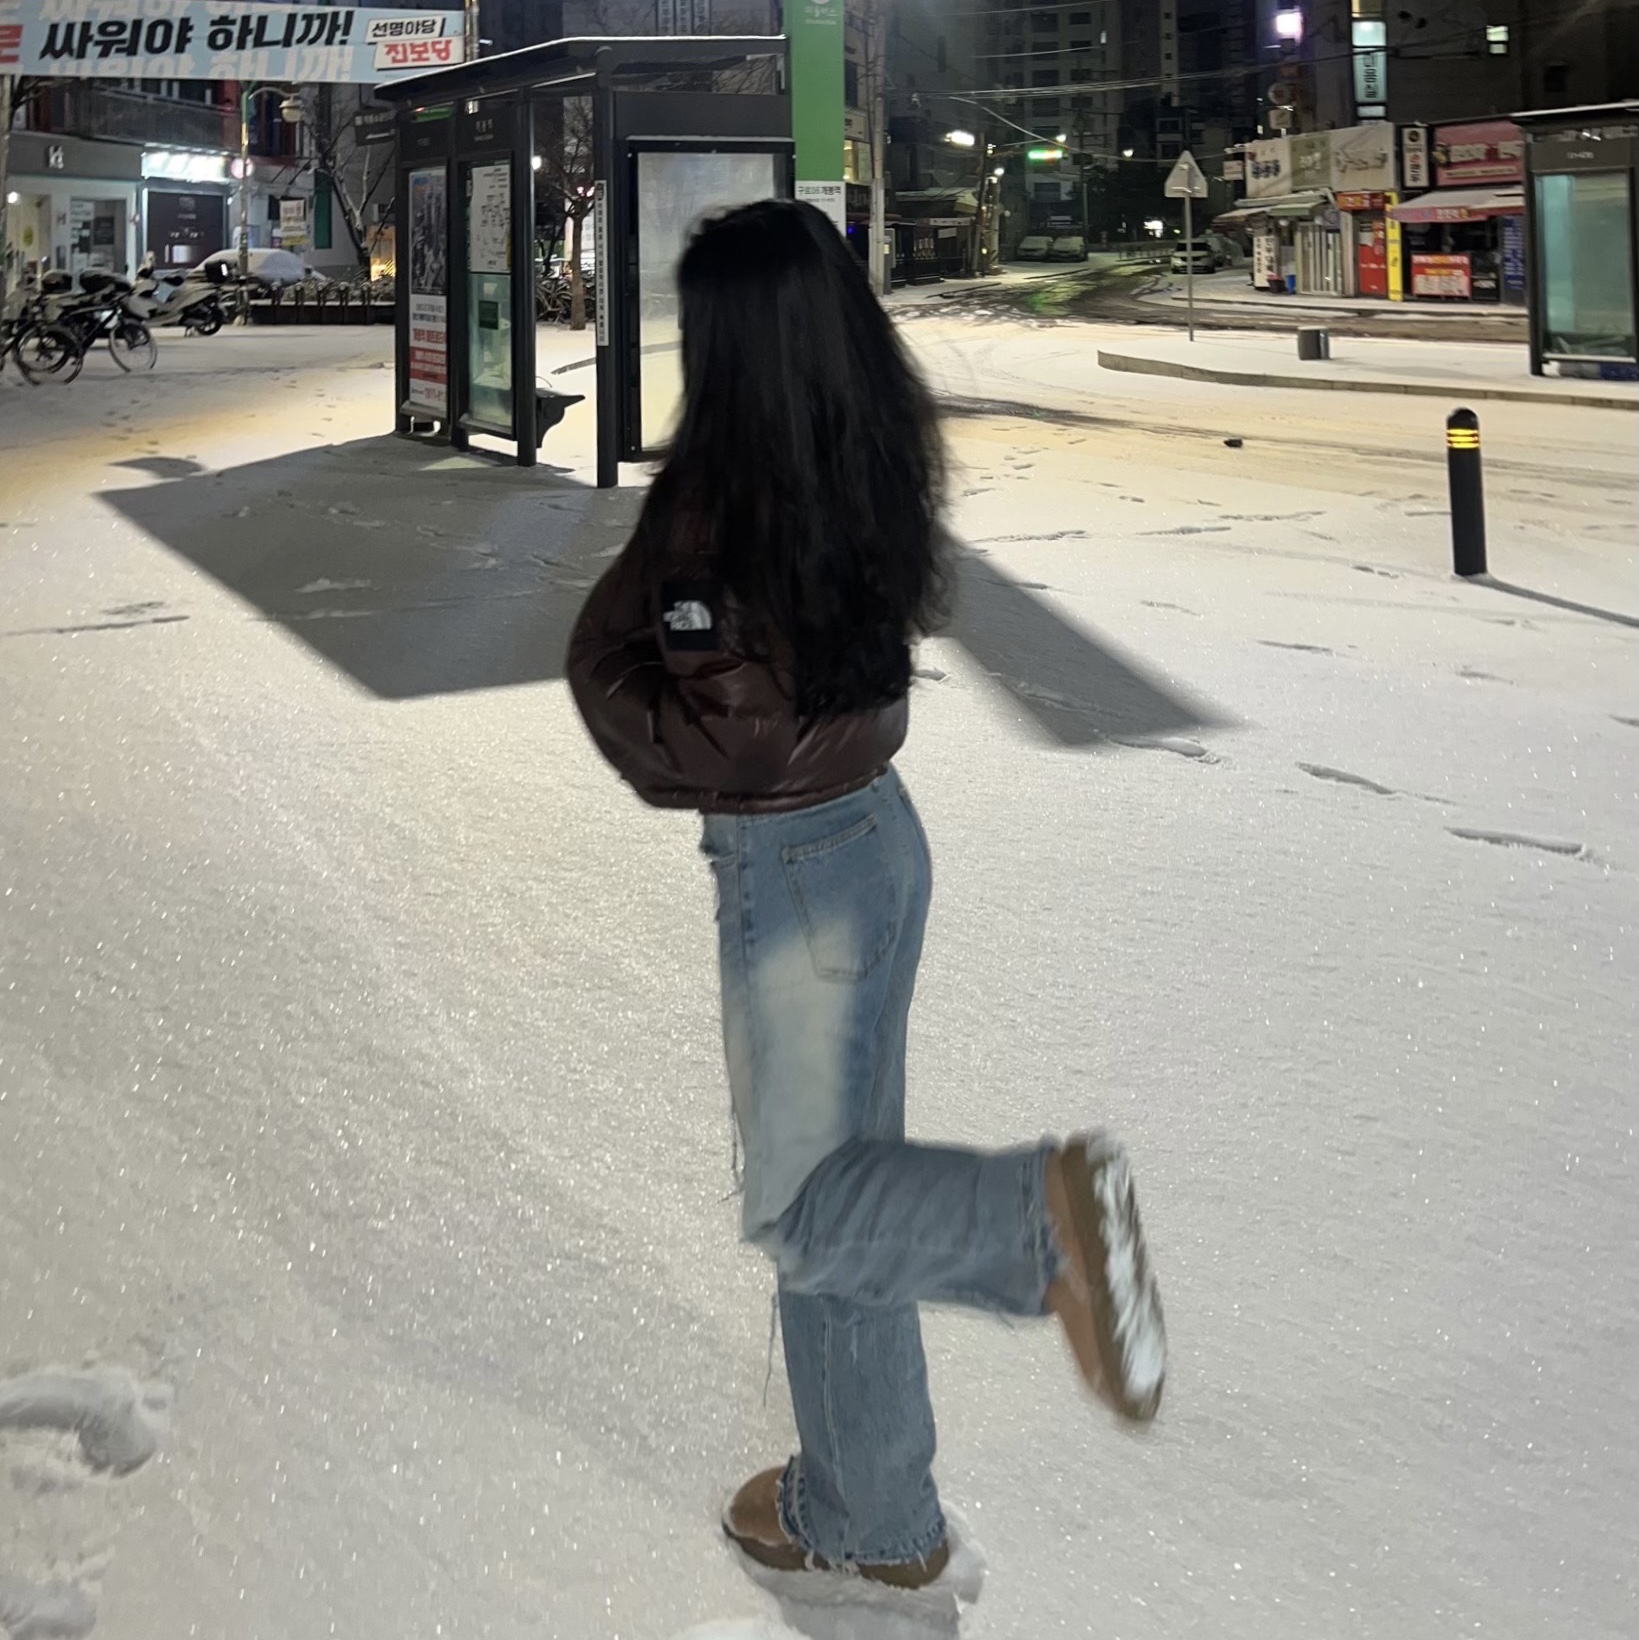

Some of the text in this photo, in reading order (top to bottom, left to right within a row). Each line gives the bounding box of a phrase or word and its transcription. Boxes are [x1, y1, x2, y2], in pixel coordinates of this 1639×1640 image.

[39, 17, 194, 60] 싸워야
[207, 10, 355, 51] 하니까!
[372, 19, 437, 38] 선명야당
[385, 39, 452, 64] 진보당
